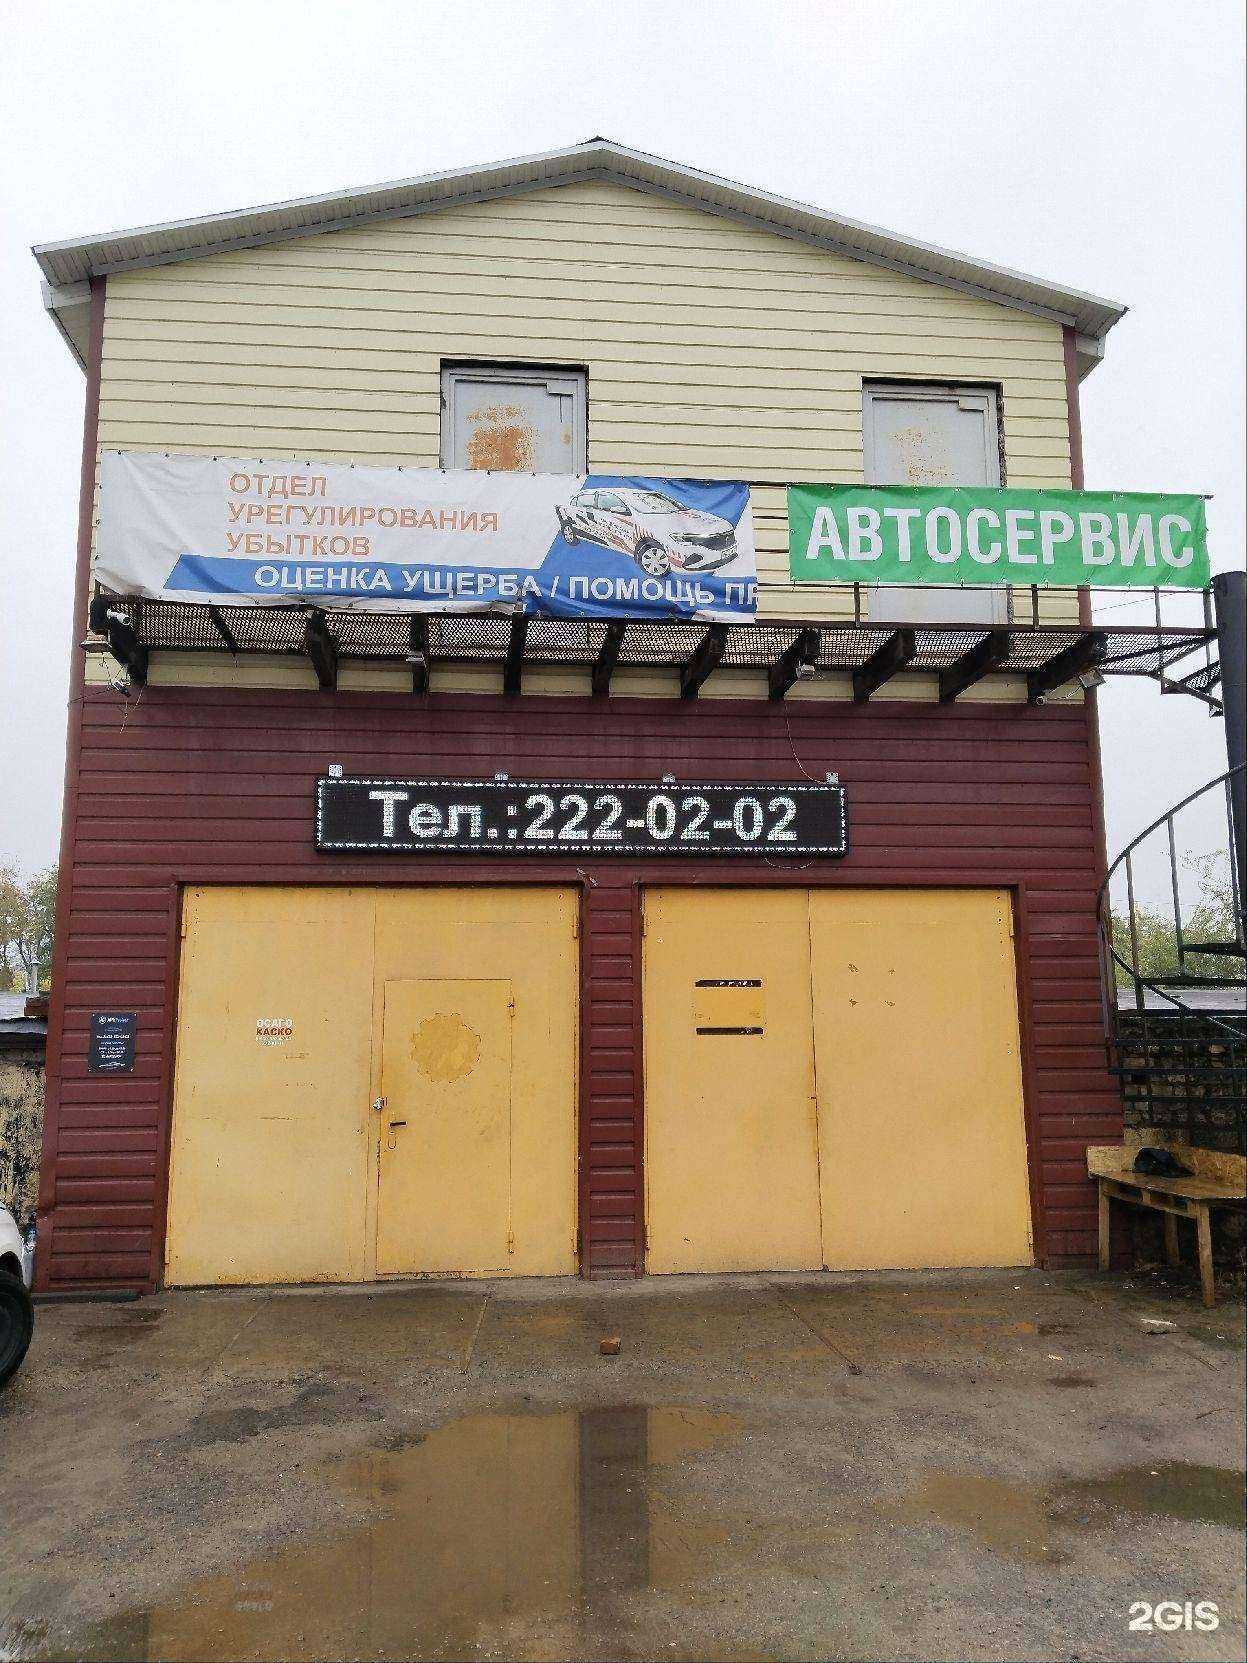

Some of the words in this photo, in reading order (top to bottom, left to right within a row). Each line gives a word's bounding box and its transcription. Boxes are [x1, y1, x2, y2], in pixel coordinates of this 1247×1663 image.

[229, 472, 327, 499] ОТДЕЛ
[227, 502, 499, 533] УРЕГУЛИРОВАНИЯ
[226, 532, 371, 556] УБЫТКОВ
[805, 506, 1195, 568] АВТОСЕРВИС
[254, 565, 393, 592] ОЦЕНКА
[403, 570, 543, 598] УЩЕРБА
[569, 575, 715, 606] ПОМОЩЬ
[256, 1027, 293, 1036] КАСКО
